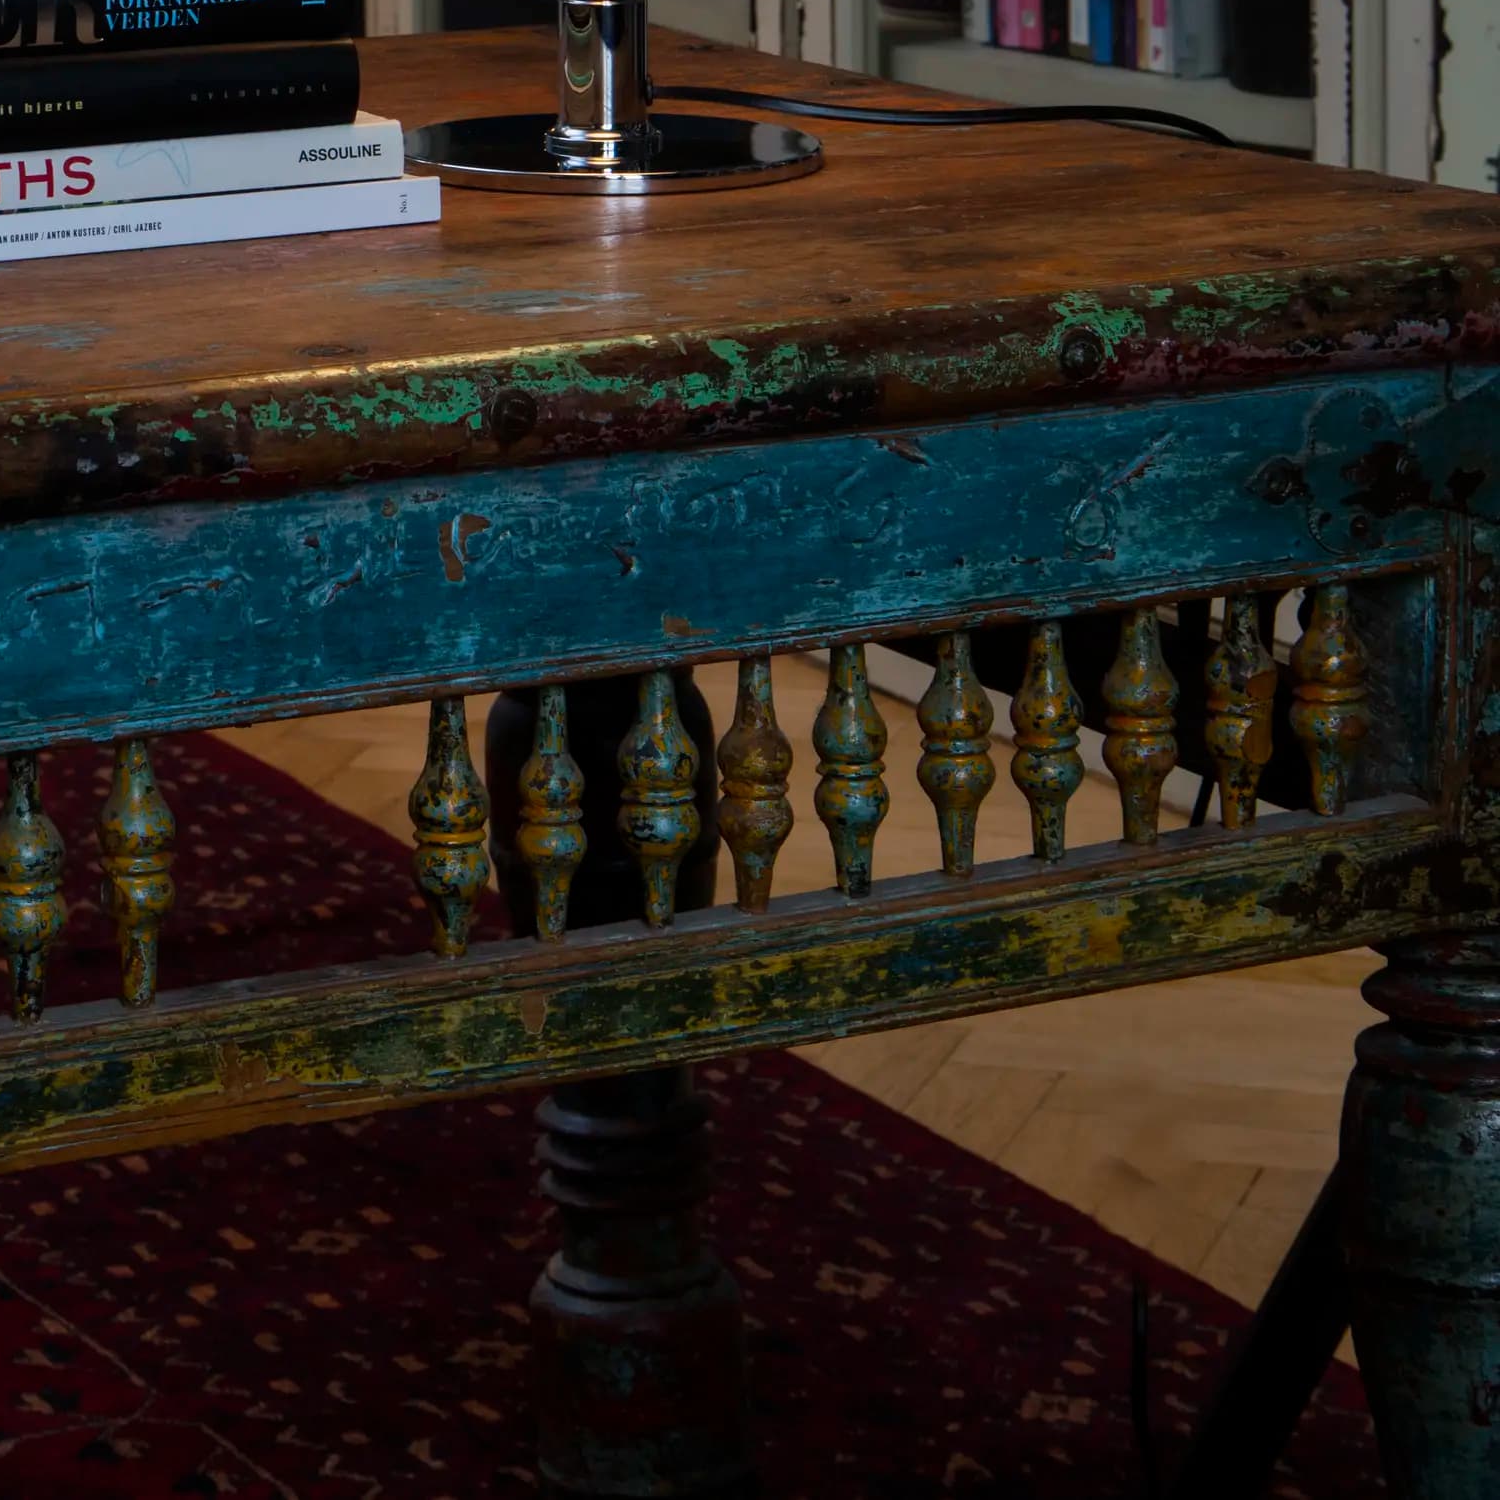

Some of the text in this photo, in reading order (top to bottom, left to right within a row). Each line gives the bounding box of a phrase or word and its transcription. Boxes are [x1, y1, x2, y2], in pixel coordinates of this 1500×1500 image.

[104, 7, 201, 32] VERDEN
[23, 99, 84, 115] hjerte
[299, 144, 381, 163] ASSOULINE
[10, 232, 39, 243] GRARUP
[47, 229, 71, 240] ANTON
[73, 226, 105, 237] KUSTERS
[113, 224, 132, 234] CIRIL
[134, 222, 162, 232] JAZBEC
